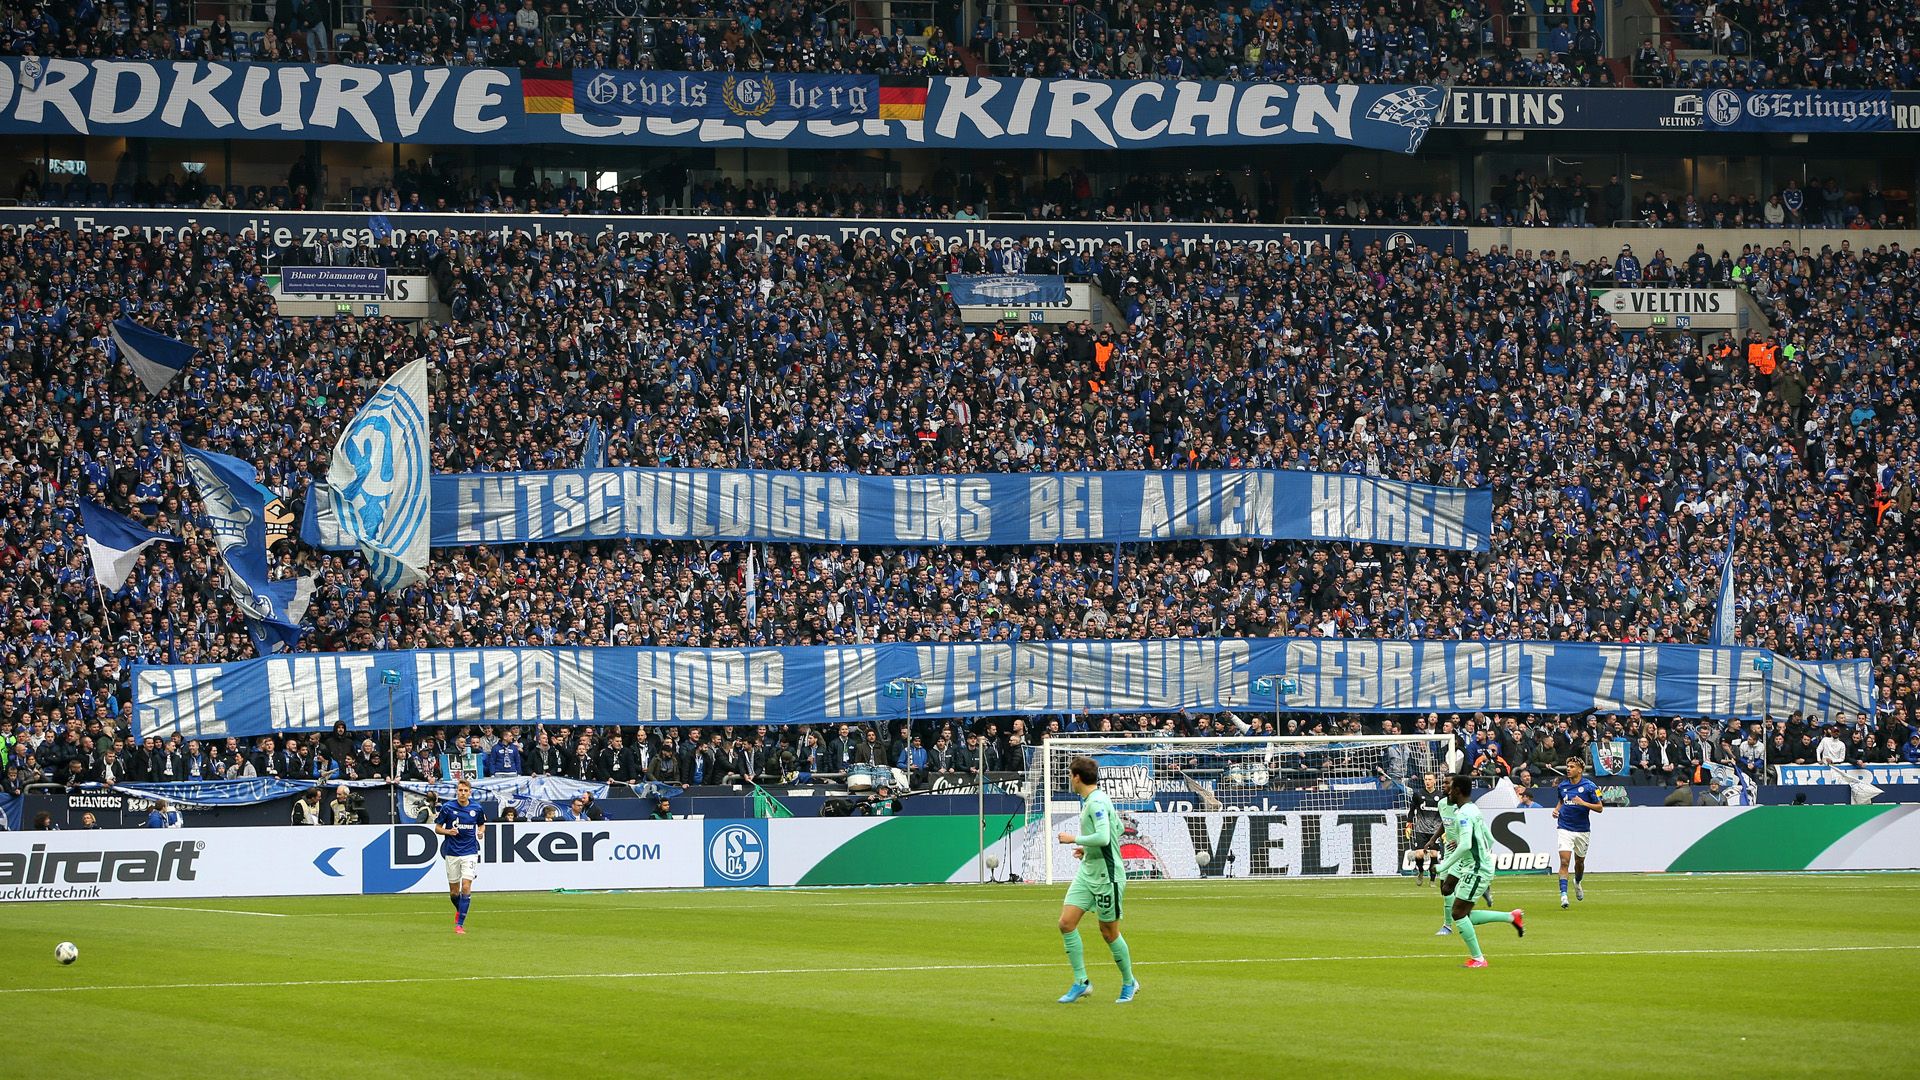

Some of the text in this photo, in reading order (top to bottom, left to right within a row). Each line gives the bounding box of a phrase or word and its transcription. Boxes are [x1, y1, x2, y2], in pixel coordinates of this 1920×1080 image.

[0, 59, 510, 142] RDKURVE
[586, 72, 869, 114] Gevels berg
[1746, 94, 1888, 123] GErlingen
[1659, 117, 1696, 127] VELTINS
[290, 271, 378, 281] Blaue Diamanten 04
[365, 306, 379, 317] N3
[1630, 292, 1720, 313] VELTINS
[1030, 312, 1043, 322] N4
[1676, 317, 1690, 326] N5
[457, 472, 859, 542] ENTSCHULDIGEN
[893, 478, 992, 541] UNS
[1029, 476, 1104, 540] BEI
[1139, 473, 1274, 538] ALLEN
[138, 667, 229, 738] SIE
[267, 655, 375, 728] MIT
[415, 650, 595, 722] HERRN
[637, 651, 784, 722] HOPP
[824, 648, 878, 718] IN
[916, 640, 1250, 714] VERBINDUNG
[1284, 640, 1555, 710] GEBRACHT
[1594, 646, 1659, 712] ZU
[69, 796, 122, 808] CHANGOS
[394, 824, 610, 865] Dlker
[609, 844, 661, 861] .COM
[1183, 812, 1531, 876] VELTS
[1491, 852, 1550, 870] ome
[1098, 894, 1112, 908] 29
